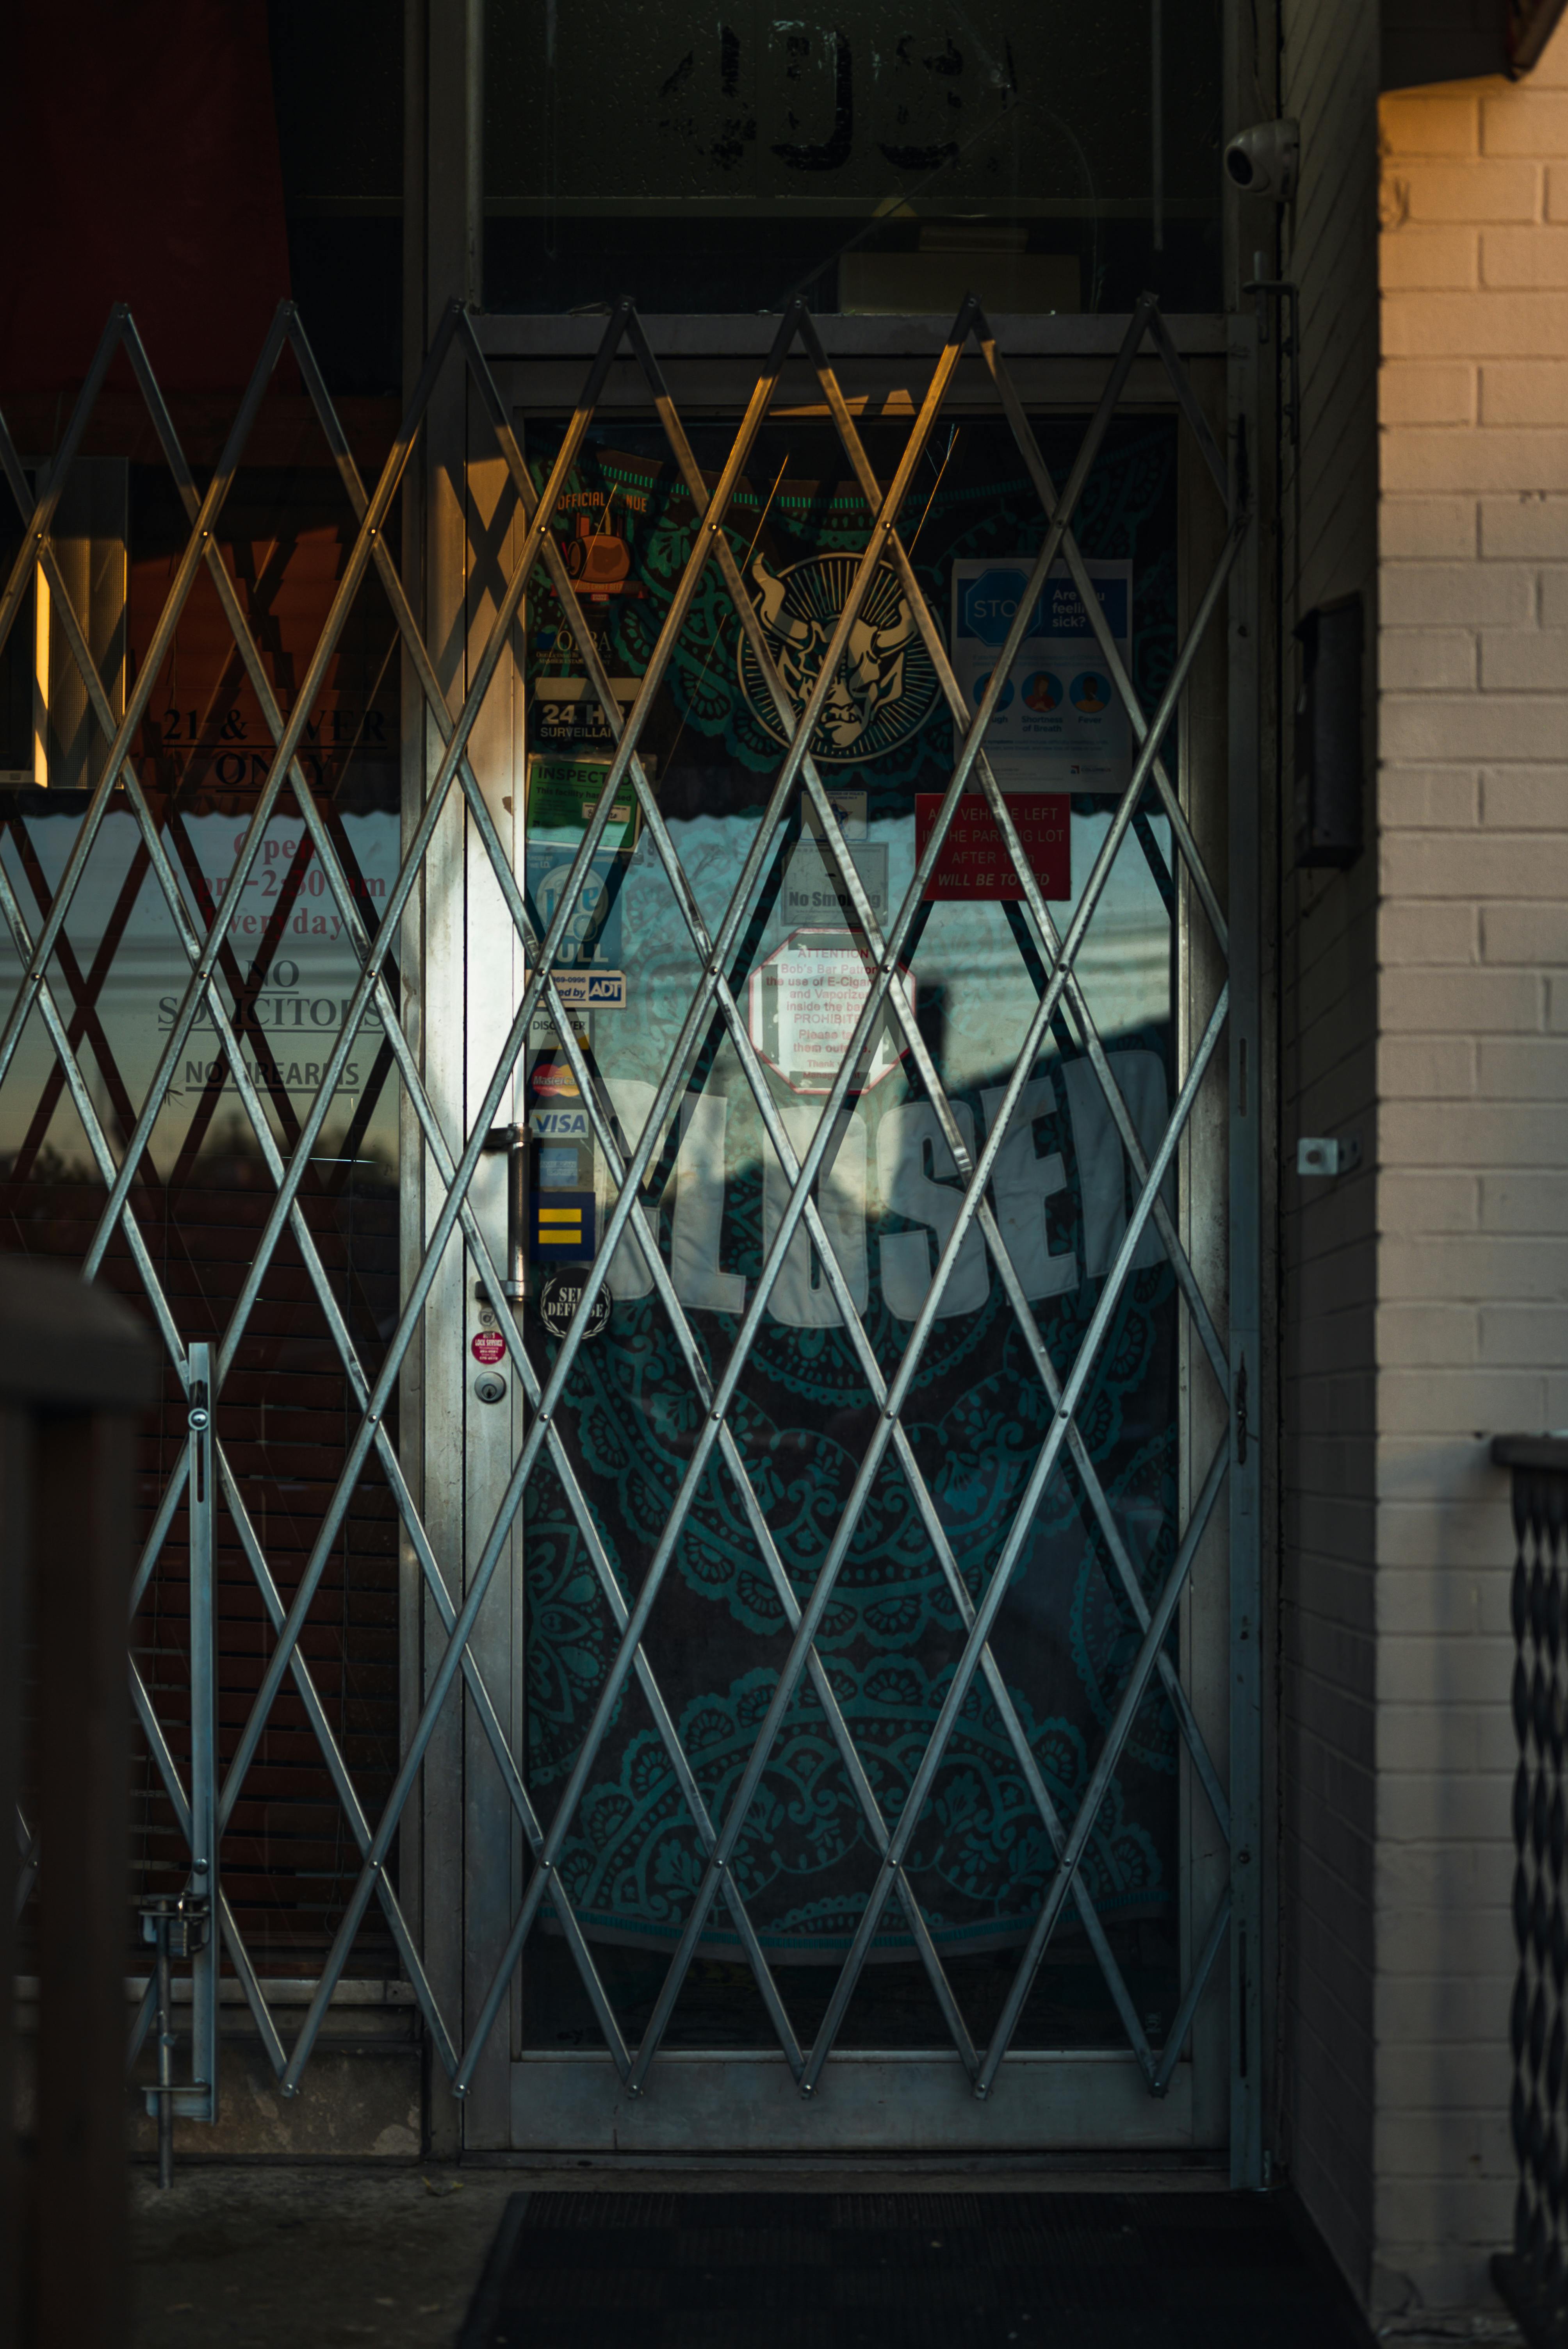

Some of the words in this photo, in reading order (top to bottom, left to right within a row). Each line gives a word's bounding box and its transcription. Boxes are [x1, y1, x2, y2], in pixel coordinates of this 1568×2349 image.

[1053, 589, 1077, 601] Are
[974, 600, 1017, 618] STO
[1052, 617, 1086, 628] sick?
[541, 704, 576, 725] 24
[163, 709, 198, 740] 21
[221, 709, 247, 740] &
[282, 709, 387, 741] VER
[217, 753, 333, 785] ONY
[538, 767, 632, 786] INSPECTD
[555, 788, 584, 799] facility
[961, 808, 1019, 820] VEHIE
[1025, 808, 1058, 820] LEFT
[1038, 829, 1065, 843] LOT
[951, 852, 997, 864] AFTER
[937, 873, 971, 886] WILL
[976, 873, 995, 886] BE
[789, 891, 809, 907] No
[798, 948, 869, 959] ATTENTION
[244, 960, 299, 987] NO
[781, 963, 813, 974] Bob's
[817, 964, 837, 974] Bar
[766, 977, 784, 986] the
[813, 977, 824, 986] of
[573, 988, 586, 998] by
[590, 981, 622, 998] ADT
[789, 989, 811, 998] and
[787, 1001, 820, 1010] inside
[824, 1001, 842, 1010] the
[799, 1029, 838, 1039] Please
[793, 1043, 821, 1053] them
[807, 1059, 835, 1068] Thank
[185, 1062, 224, 1084] NO
[534, 1114, 586, 1133] VISA
